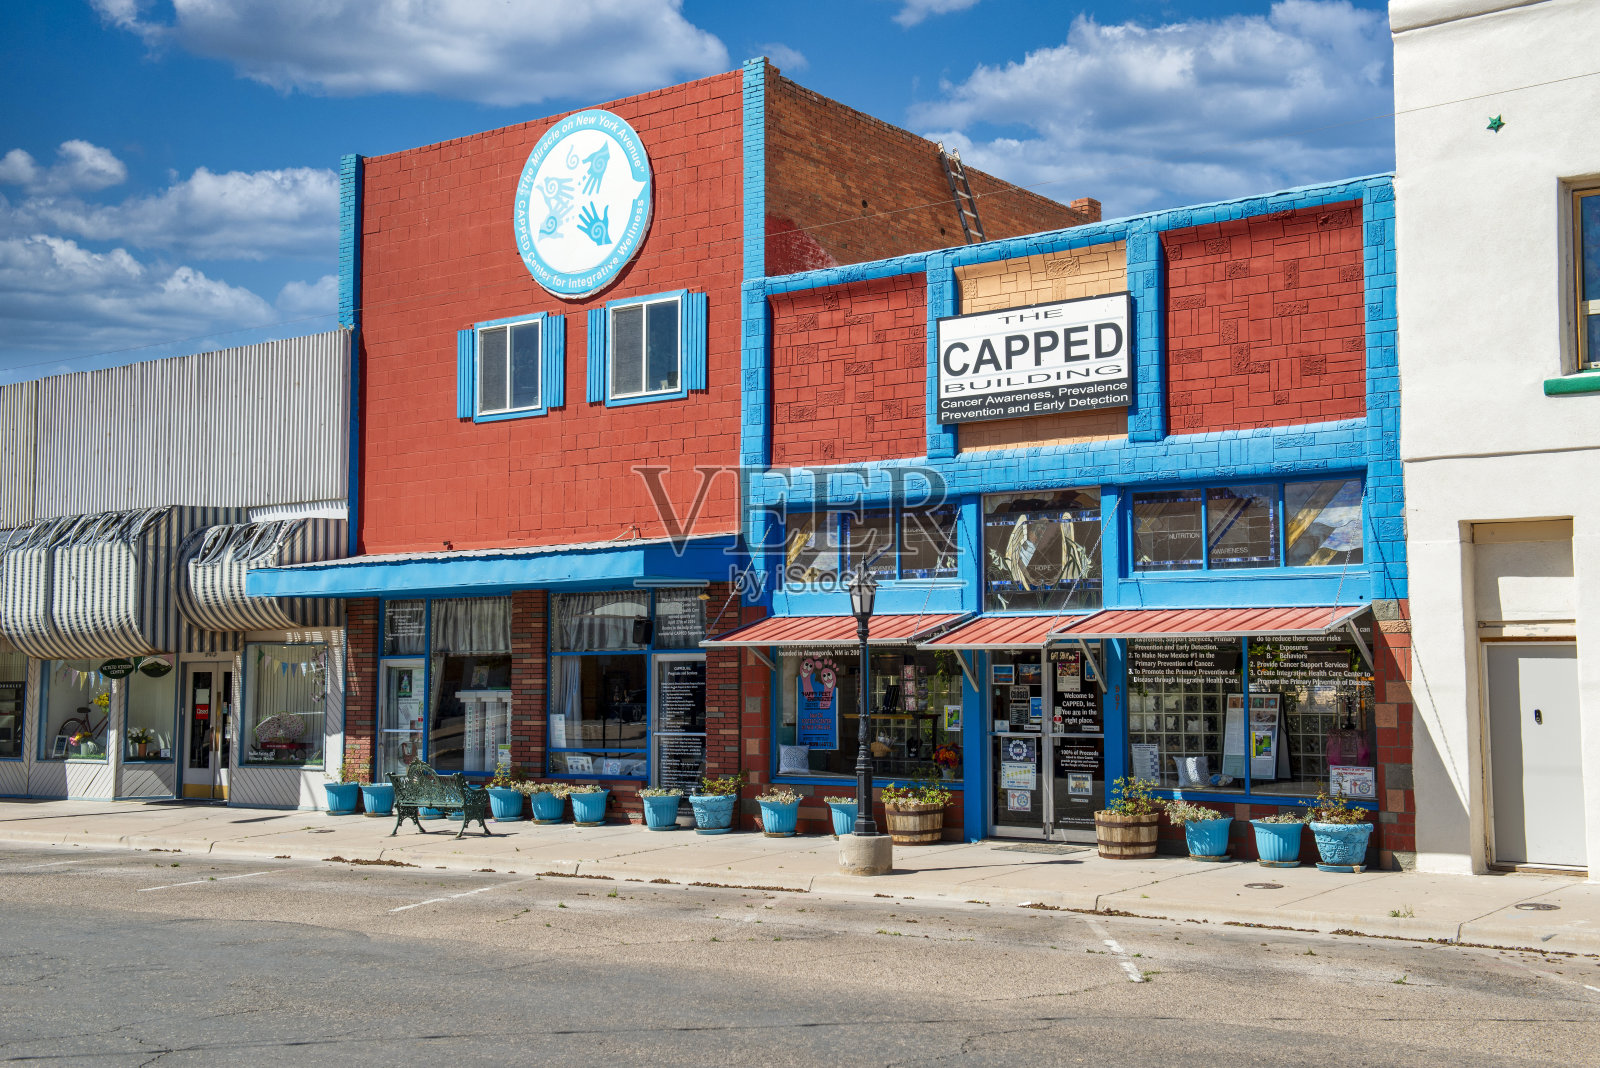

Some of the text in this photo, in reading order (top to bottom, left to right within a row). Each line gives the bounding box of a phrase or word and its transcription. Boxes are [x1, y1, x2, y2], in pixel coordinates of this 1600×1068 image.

[532, 130, 560, 168] Miracle
[562, 122, 574, 134] on
[576, 115, 596, 125] New
[598, 116, 619, 132] York
[518, 200, 644, 288] CAPPED Center for Integrative Wellness
[998, 308, 1064, 324] THE
[943, 322, 1124, 377] CAPPED
[944, 364, 1122, 394] BUILDING
[941, 382, 1128, 409] Cancer Awareness, Prevalence
[941, 394, 1128, 421] Prevention and Early Detection
